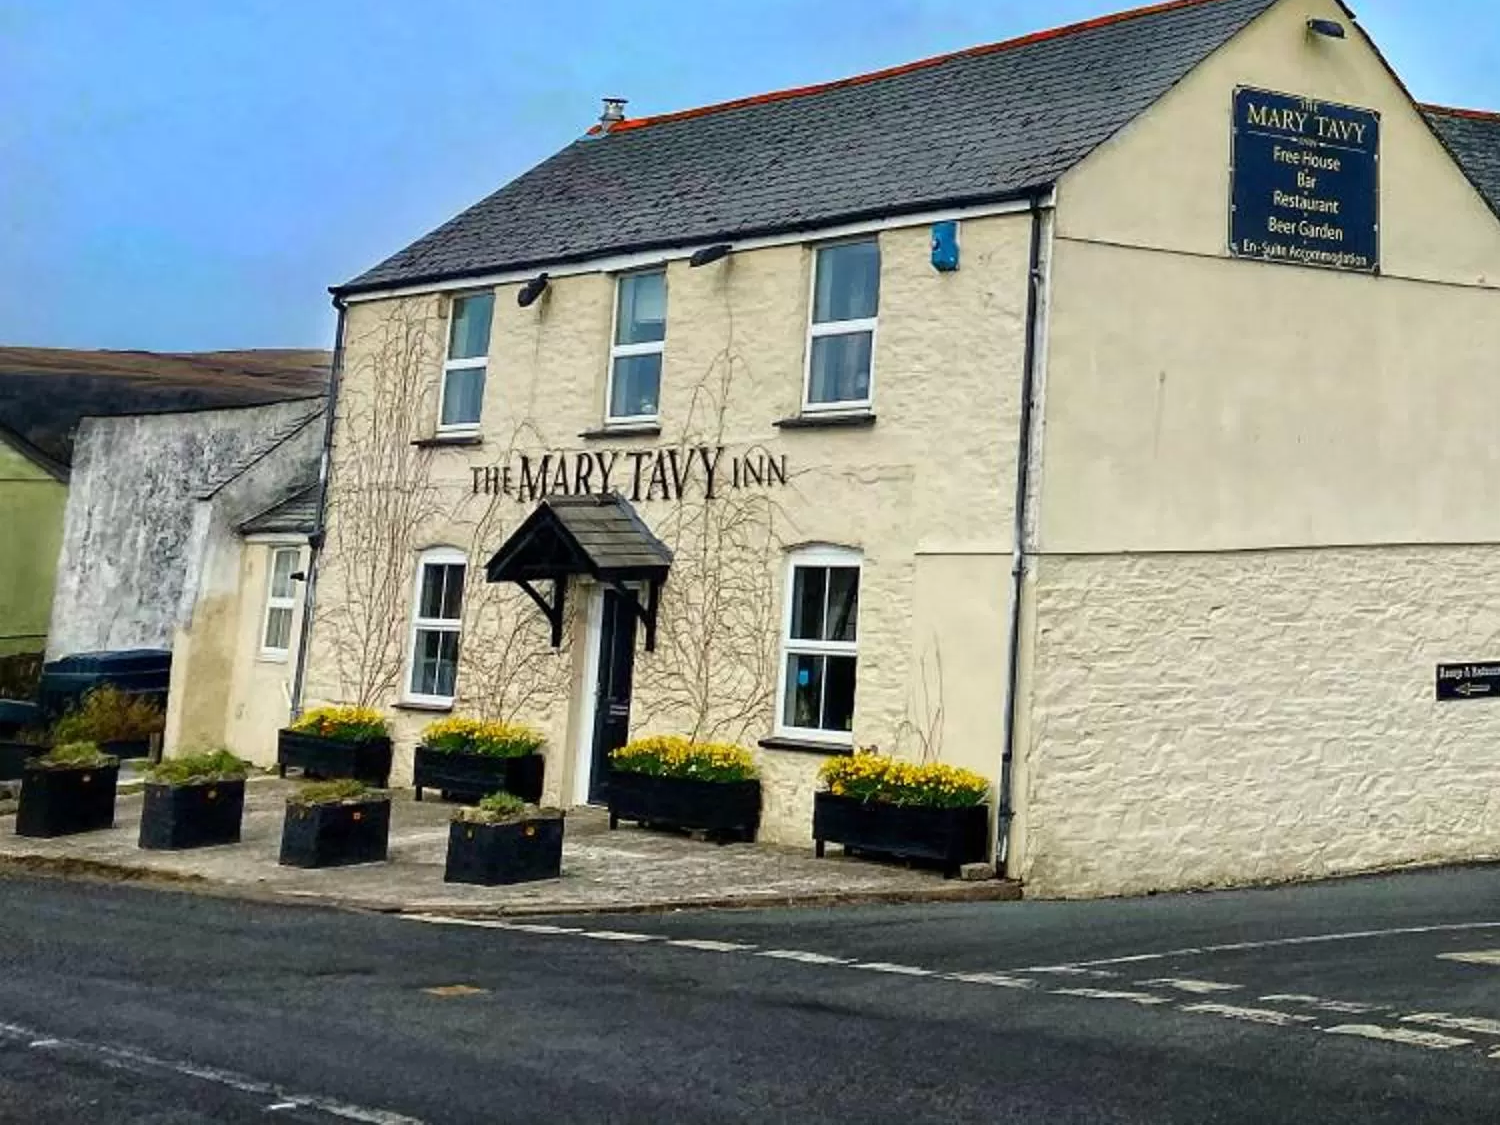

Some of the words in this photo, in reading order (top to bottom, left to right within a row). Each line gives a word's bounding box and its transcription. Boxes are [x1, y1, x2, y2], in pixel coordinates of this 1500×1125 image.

[1299, 98, 1320, 113] THE
[1247, 102, 1308, 133] MARY
[1314, 116, 1366, 144] TAVY
[1273, 146, 1300, 165] Free
[1302, 151, 1341, 171] House
[1297, 171, 1317, 189] Bar
[1273, 190, 1340, 214] Restaurant
[1267, 216, 1296, 234] Beer
[1300, 220, 1343, 241] Garden
[470, 466, 512, 495] THE
[518, 450, 619, 502] MARY
[626, 446, 725, 502] TAVY
[732, 454, 787, 489] INN
